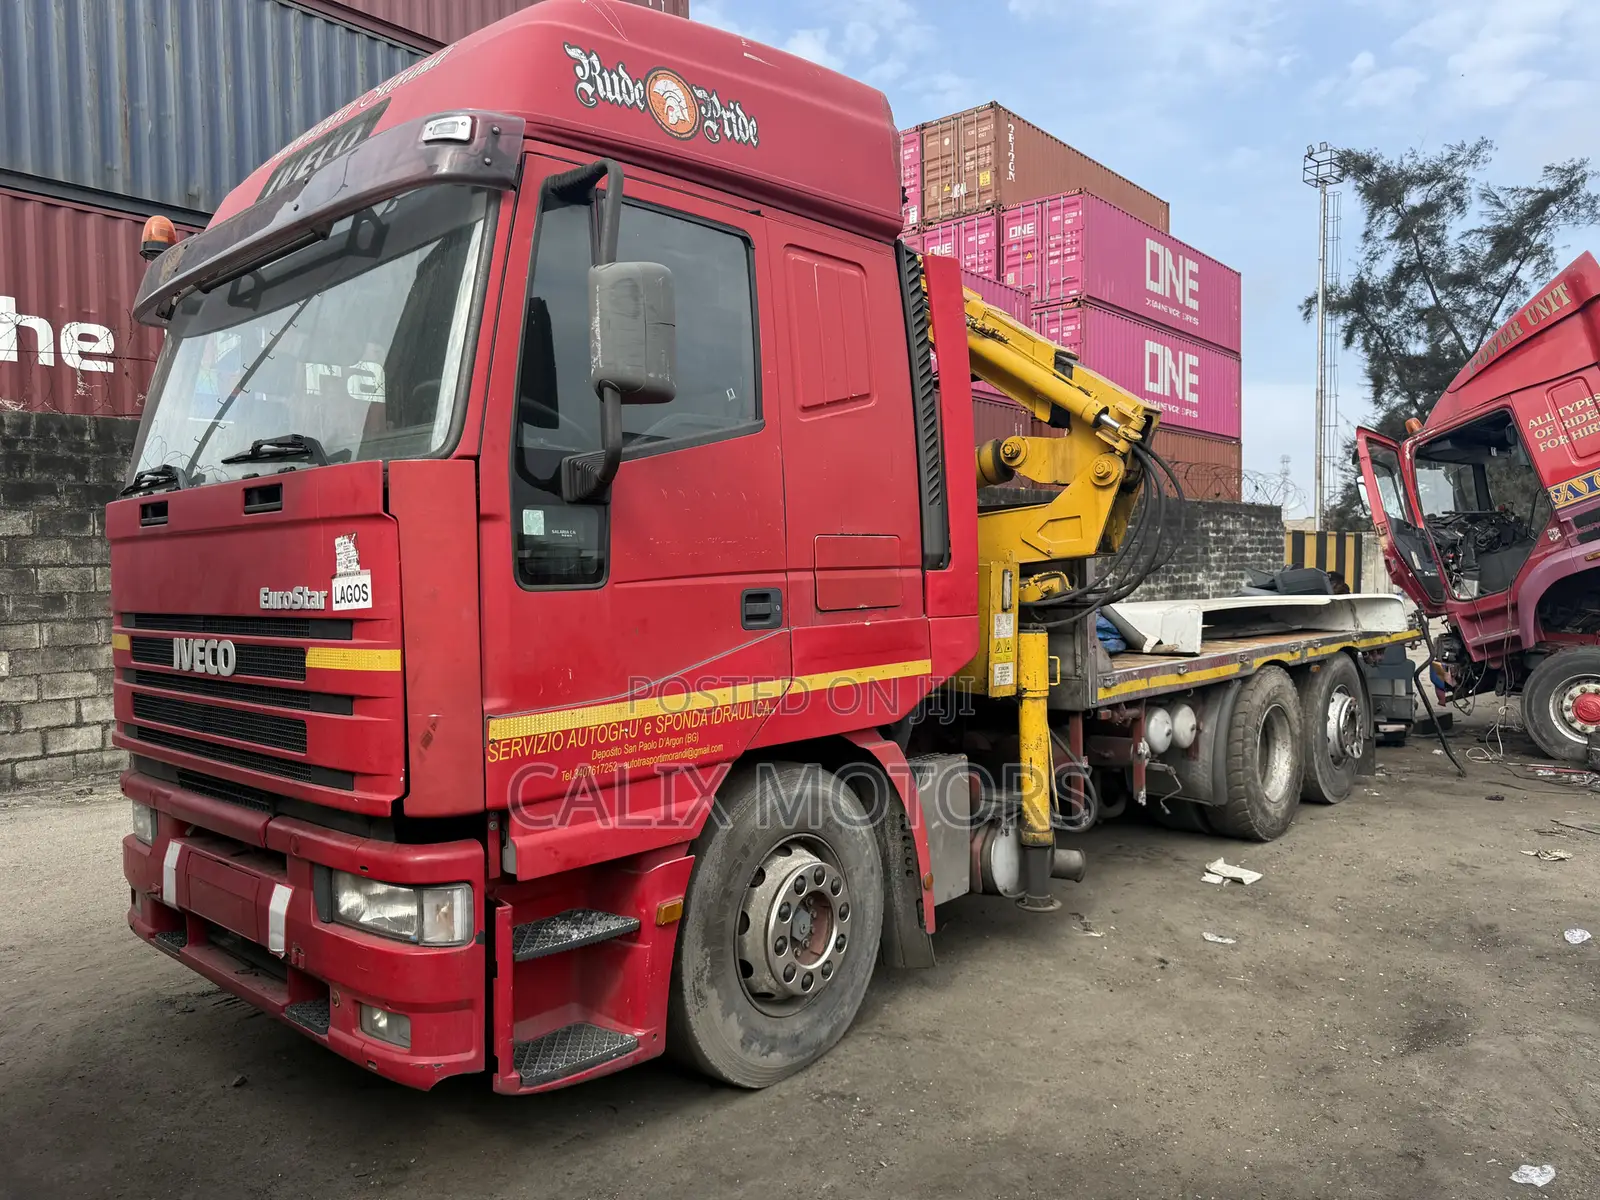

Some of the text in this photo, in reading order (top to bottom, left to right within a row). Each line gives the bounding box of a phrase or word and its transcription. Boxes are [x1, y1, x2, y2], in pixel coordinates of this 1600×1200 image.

[563, 42, 760, 148] Rude Pride
[1009, 223, 1034, 238] ONE
[928, 243, 951, 255] ONE
[1146, 238, 1199, 311] ONE
[1469, 282, 1572, 376] POWER UNIT
[1145, 340, 1199, 403] ONE
[1528, 412, 1555, 429] ALL
[1535, 425, 1554, 439] OF
[1539, 435, 1569, 453] FOR
[259, 586, 328, 610] EuroStar
[334, 583, 370, 605] LAGOS
[173, 637, 236, 677] IVECO
[487, 730, 564, 762] SERVIZIO
[644, 721, 652, 736] e
[655, 709, 709, 734] SPONDA
[711, 700, 771, 725] IDRAULICA
[591, 732, 699, 762] Deposito San Paolo D'Argon (BG)
